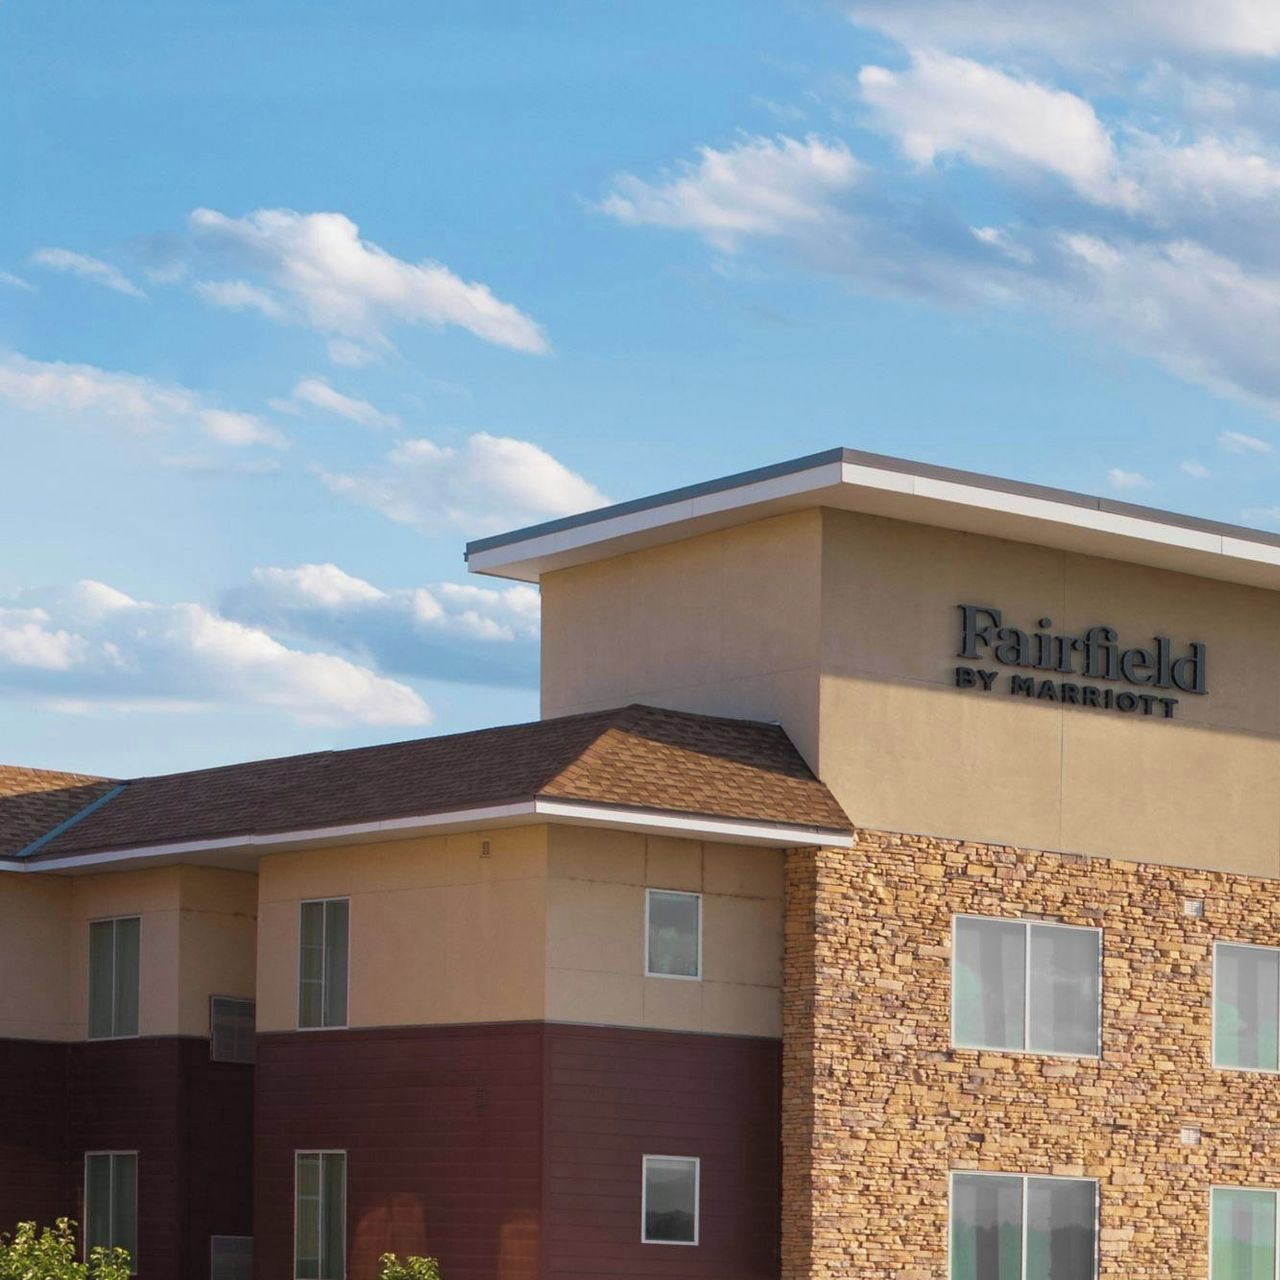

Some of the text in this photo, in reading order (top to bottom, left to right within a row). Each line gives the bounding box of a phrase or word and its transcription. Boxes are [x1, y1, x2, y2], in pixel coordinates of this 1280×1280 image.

[956, 604, 1209, 695] Fairfield
[955, 667, 1178, 718] BY MARRIOTT
